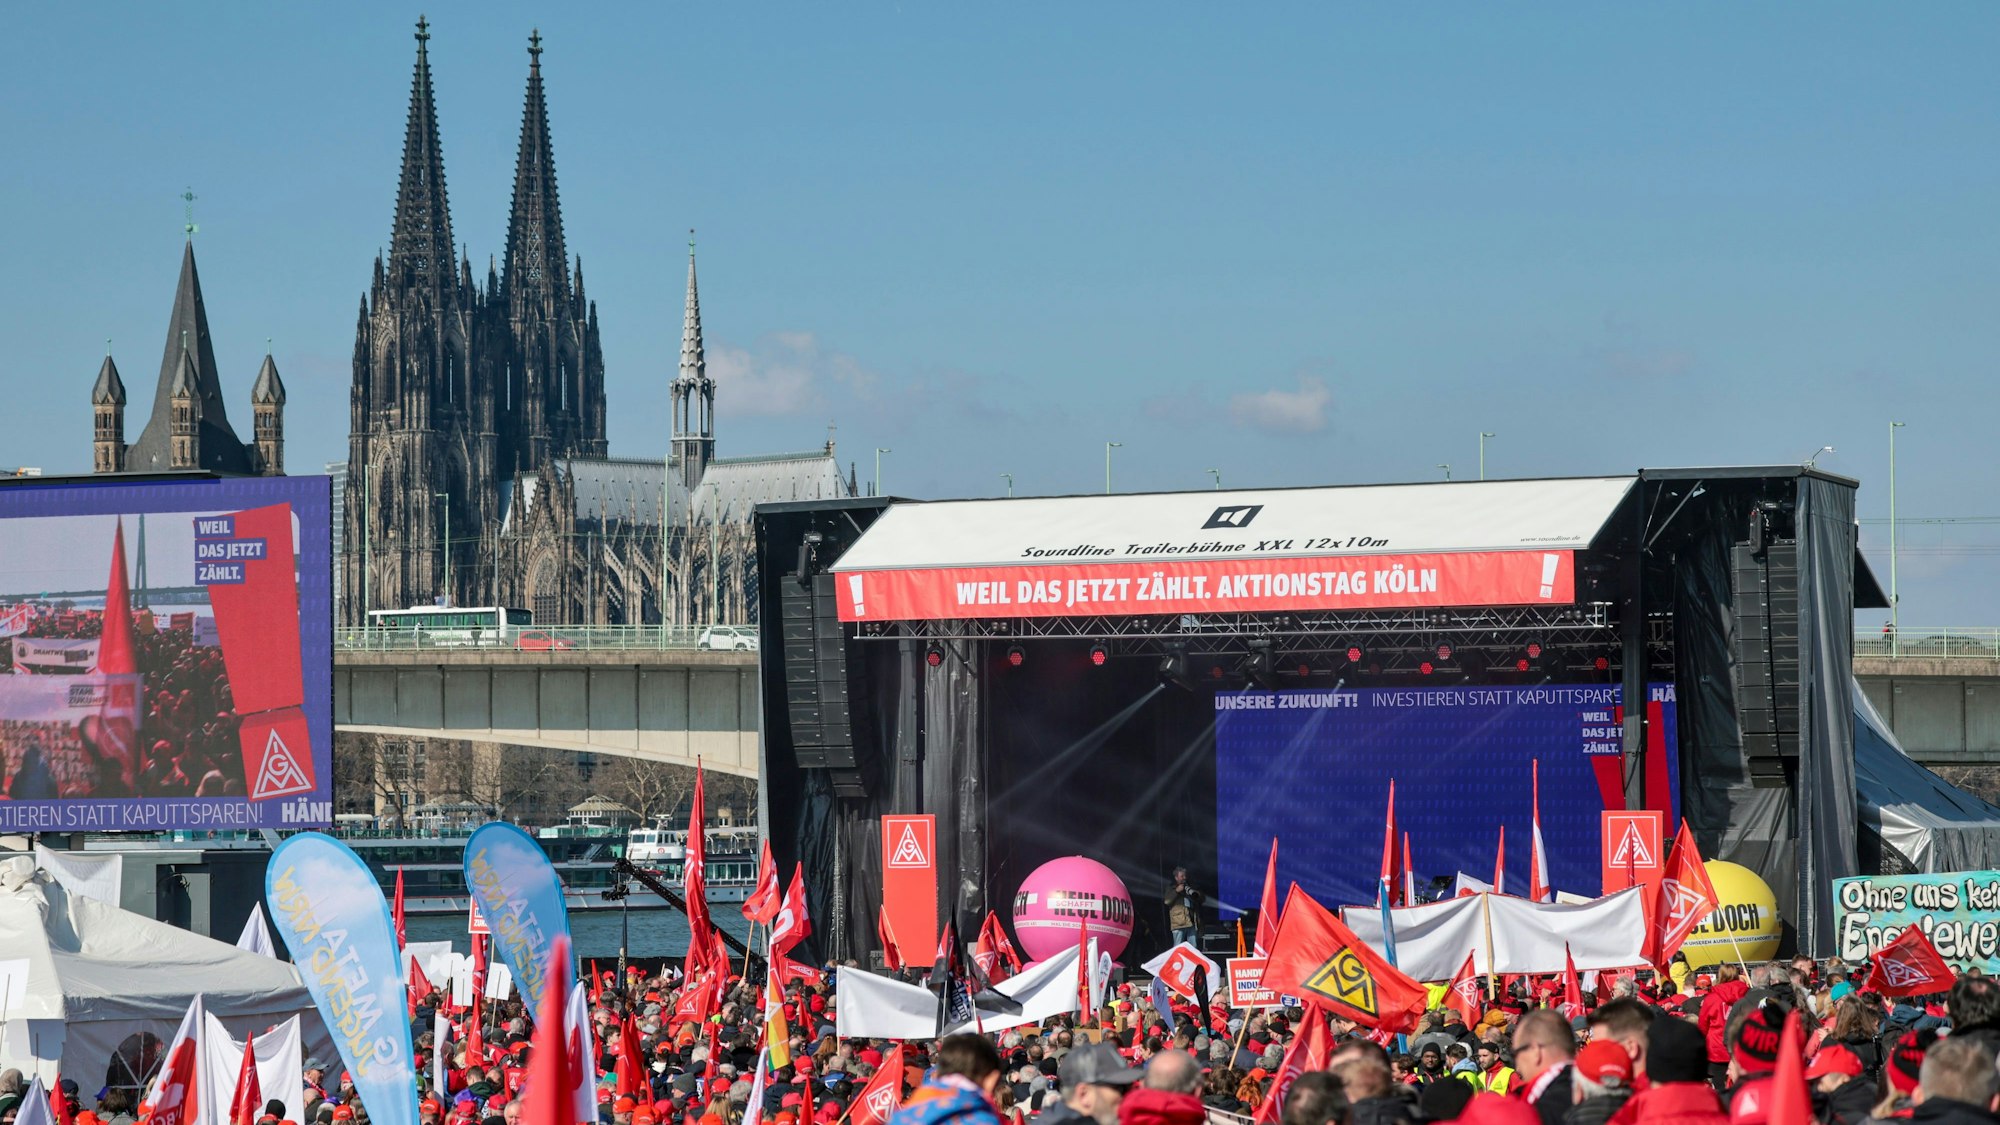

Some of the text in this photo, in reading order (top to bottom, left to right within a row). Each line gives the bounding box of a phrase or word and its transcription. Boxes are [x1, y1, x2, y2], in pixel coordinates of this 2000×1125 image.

[199, 521, 230, 534] WEIL
[199, 543, 262, 559] DAS JETZT
[1021, 545, 1115, 557] Soundline
[1125, 542, 1246, 555] Trailerbühne
[1252, 539, 1294, 551] XXL
[199, 564, 241, 580] ZÄHLT.
[956, 581, 1011, 605] WEIL
[1017, 580, 1062, 604] DAS
[1066, 578, 1130, 608] JETZT
[1136, 572, 1211, 601] ZÄHLT.
[1216, 570, 1366, 599] AKTIONSTAG
[1373, 563, 1437, 594] KÖLN
[1215, 695, 1275, 710] UNSERE
[1278, 693, 1358, 709] ZUKUNFT!
[1372, 690, 1465, 707] INVESTIEREN
[1469, 690, 1513, 706] STATT
[1516, 688, 1622, 704] KAPUTTSPARE
[1583, 712, 1610, 722] WEIL
[1583, 726, 1623, 739] DAS JET
[1583, 741, 1620, 753] ZÄHLT.
[0, 806, 62, 827] TIEREN
[66, 804, 118, 826] STATT
[122, 802, 264, 825] KAPUTTSPAREN!
[1840, 880, 1907, 912] Ohne
[1912, 883, 1960, 911] uns
[1712, 903, 1760, 932] DOCH
